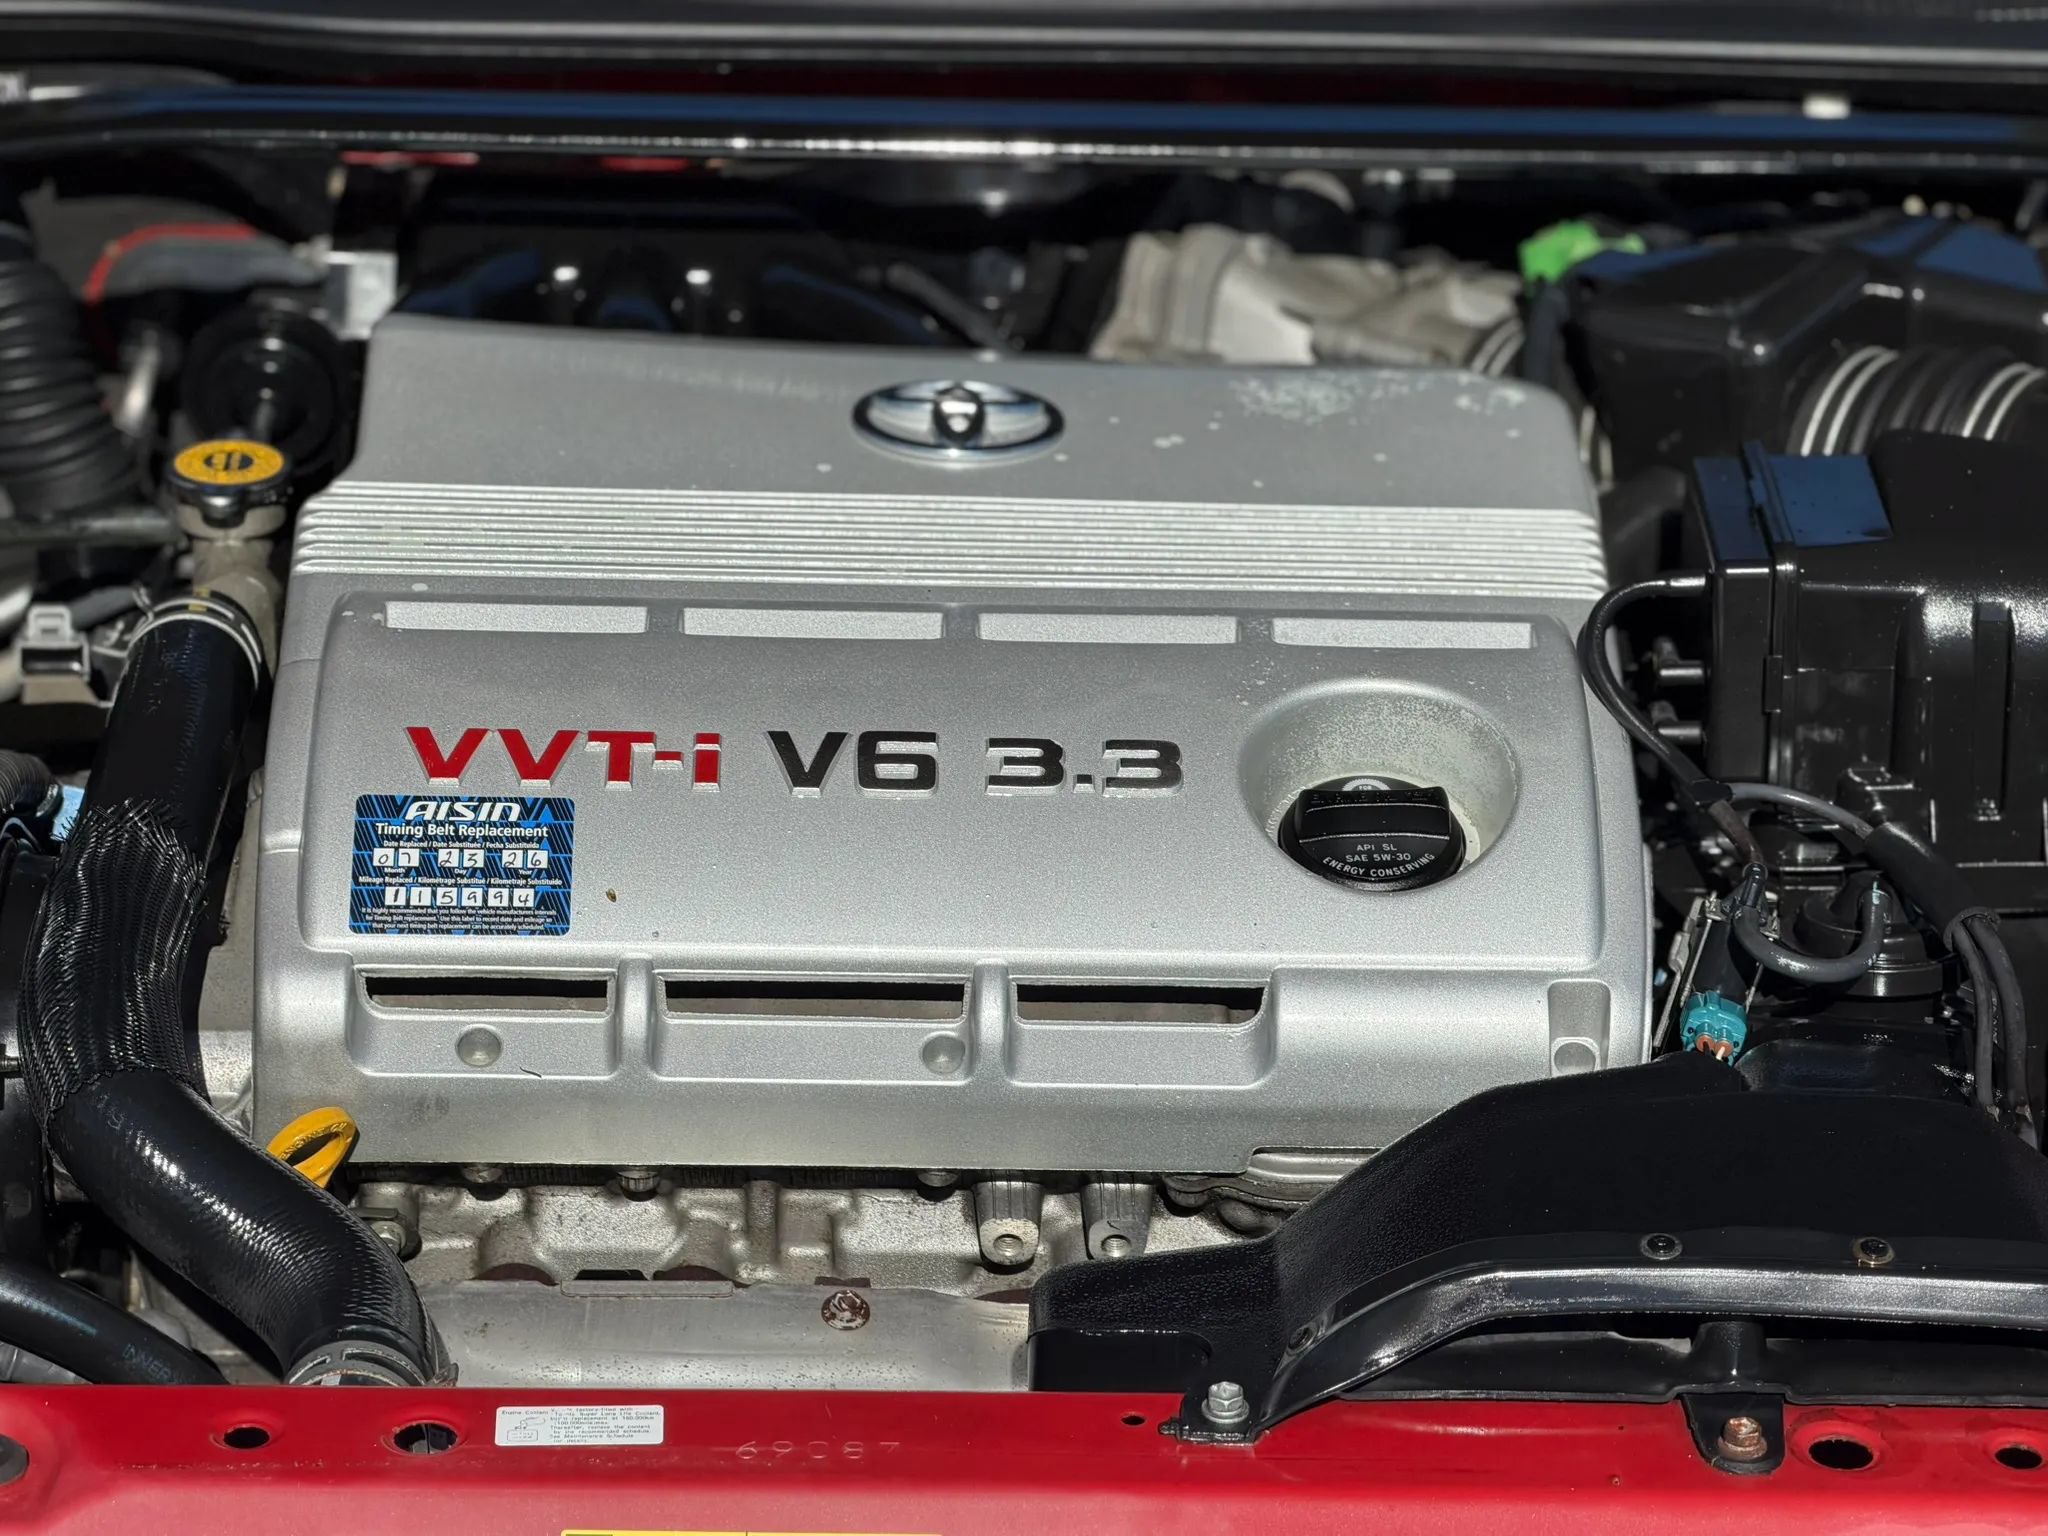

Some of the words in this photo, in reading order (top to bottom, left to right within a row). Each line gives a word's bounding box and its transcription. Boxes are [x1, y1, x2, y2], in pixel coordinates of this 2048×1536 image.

[405, 726, 721, 789] VVT-i
[764, 730, 939, 798] V6
[984, 737, 1184, 797] 3.3
[404, 801, 521, 822] AISIN
[375, 823, 424, 837] Timing
[427, 823, 455, 836] Belt
[459, 824, 549, 838] Replacement
[399, 841, 428, 849] Replaced
[1322, 857, 1366, 876] ENERGY
[1370, 853, 1435, 877] CONSERVING
[1345, 854, 1368, 862] SAE
[1373, 853, 1411, 862] 5W-30
[358, 876, 384, 884] Mileage
